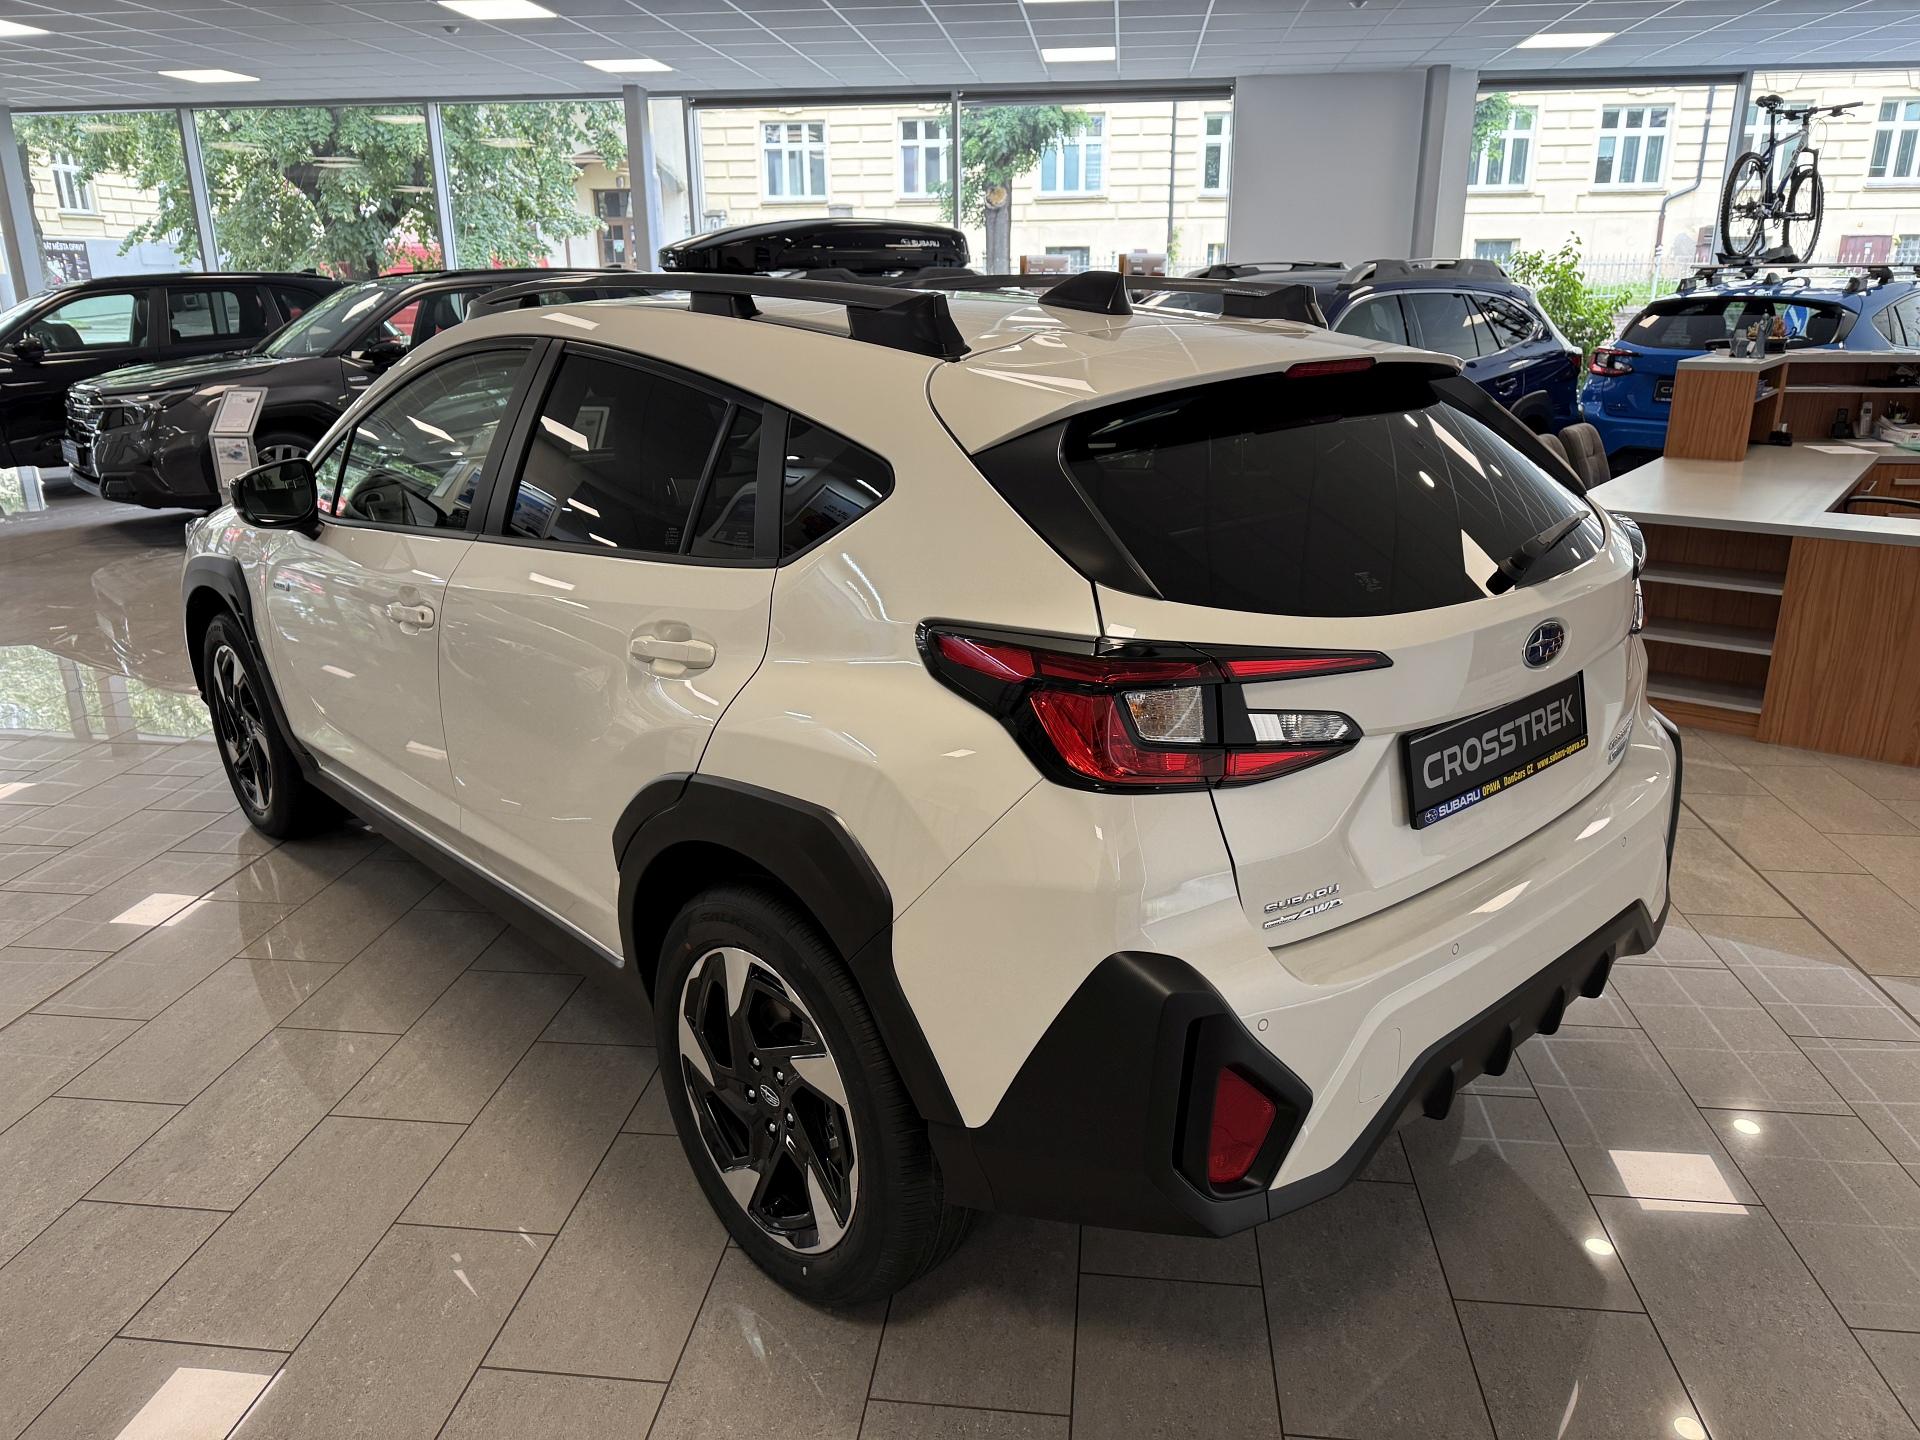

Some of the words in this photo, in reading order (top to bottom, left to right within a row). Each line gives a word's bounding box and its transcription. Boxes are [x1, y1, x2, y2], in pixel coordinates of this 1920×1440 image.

[1423, 694, 1575, 789] CROSSTREK
[1439, 789, 1481, 817] SUBARU
[1482, 779, 1501, 797] OPAVA
[1503, 768, 1526, 787] DanCars
[1526, 763, 1534, 776] CZ
[1536, 738, 1587, 770] www.subaru-opava.cz
[1264, 883, 1341, 913] SUBARU
